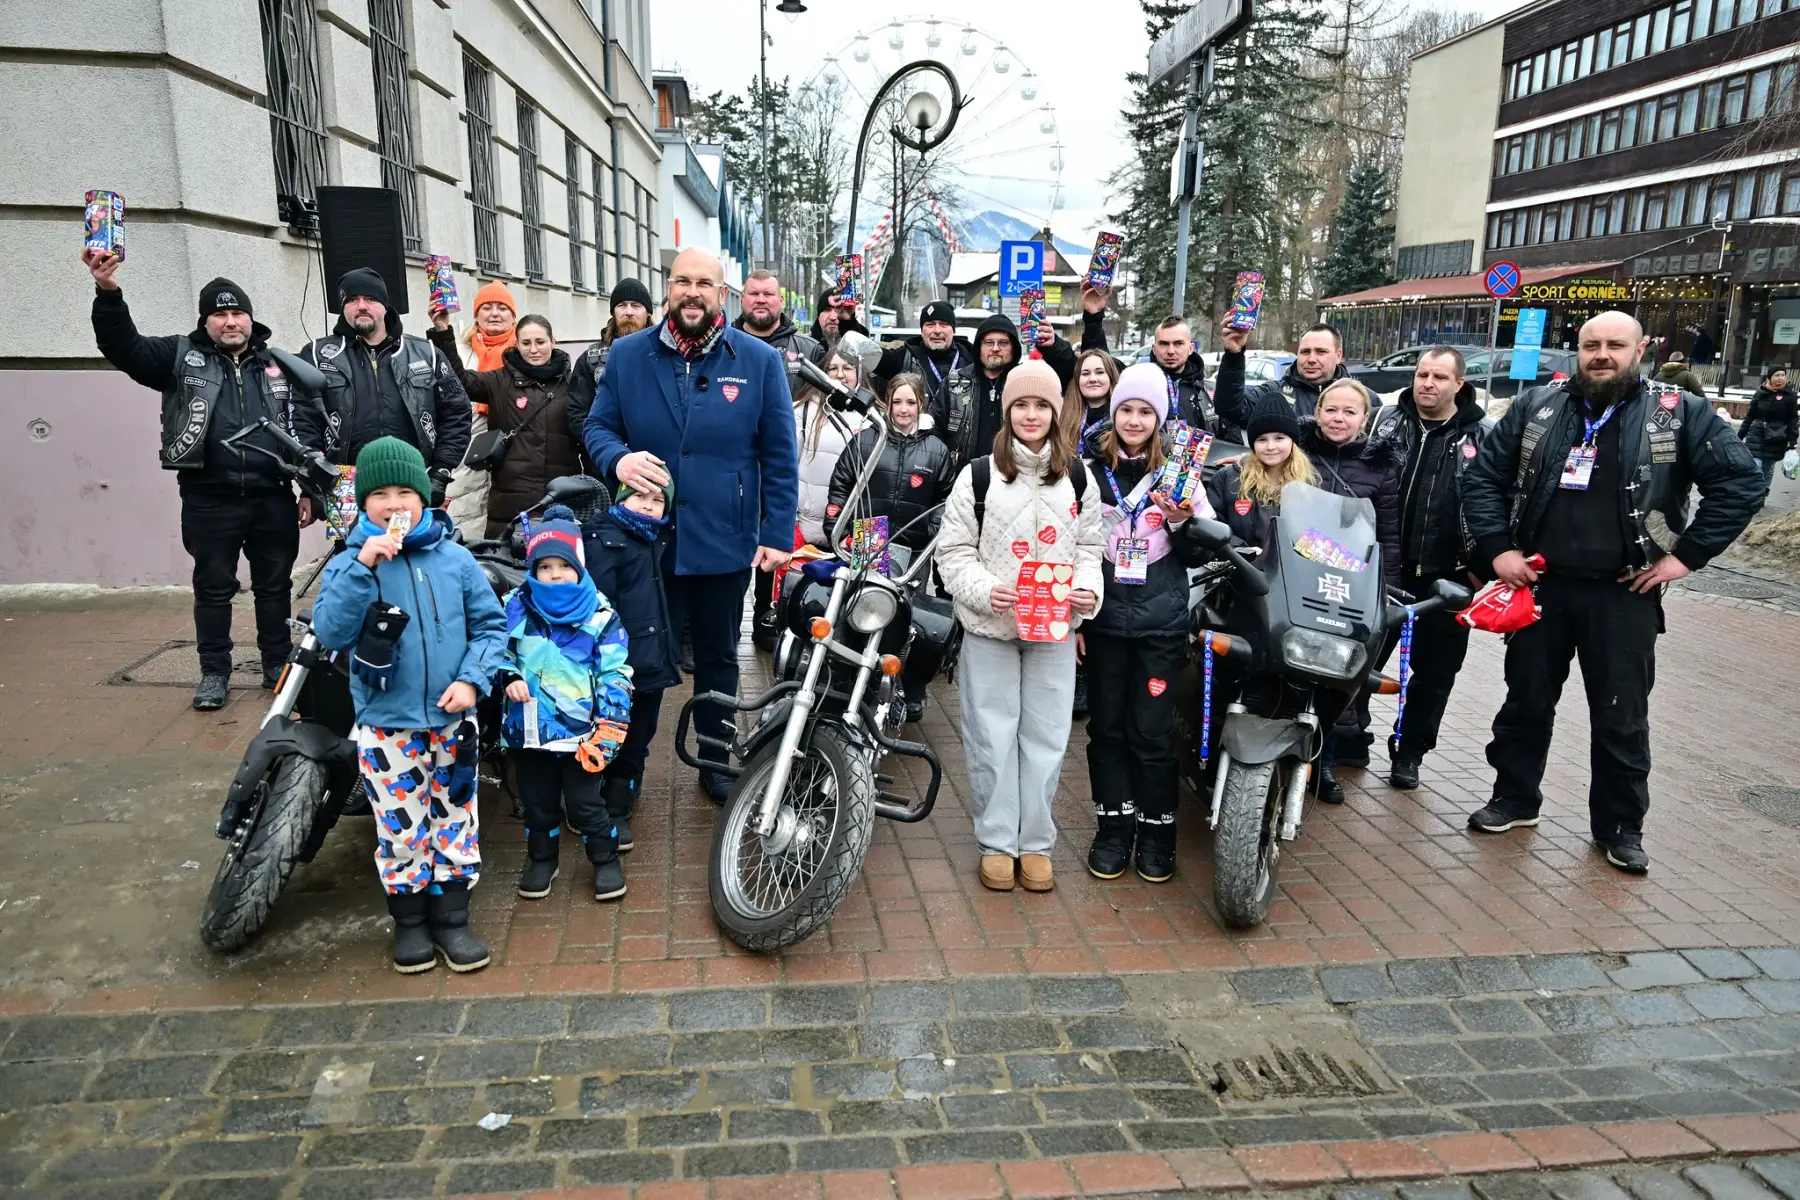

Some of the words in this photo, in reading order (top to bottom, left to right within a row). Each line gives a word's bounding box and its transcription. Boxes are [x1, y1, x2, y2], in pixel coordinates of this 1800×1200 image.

[1010, 245, 1035, 280] P
[1522, 286, 1565, 299] SPORT
[1568, 286, 1627, 299] CORNER
[716, 376, 748, 384] ZAKOPANE
[169, 401, 206, 460] KROSNO
[1316, 616, 1347, 629] SUZUKI
